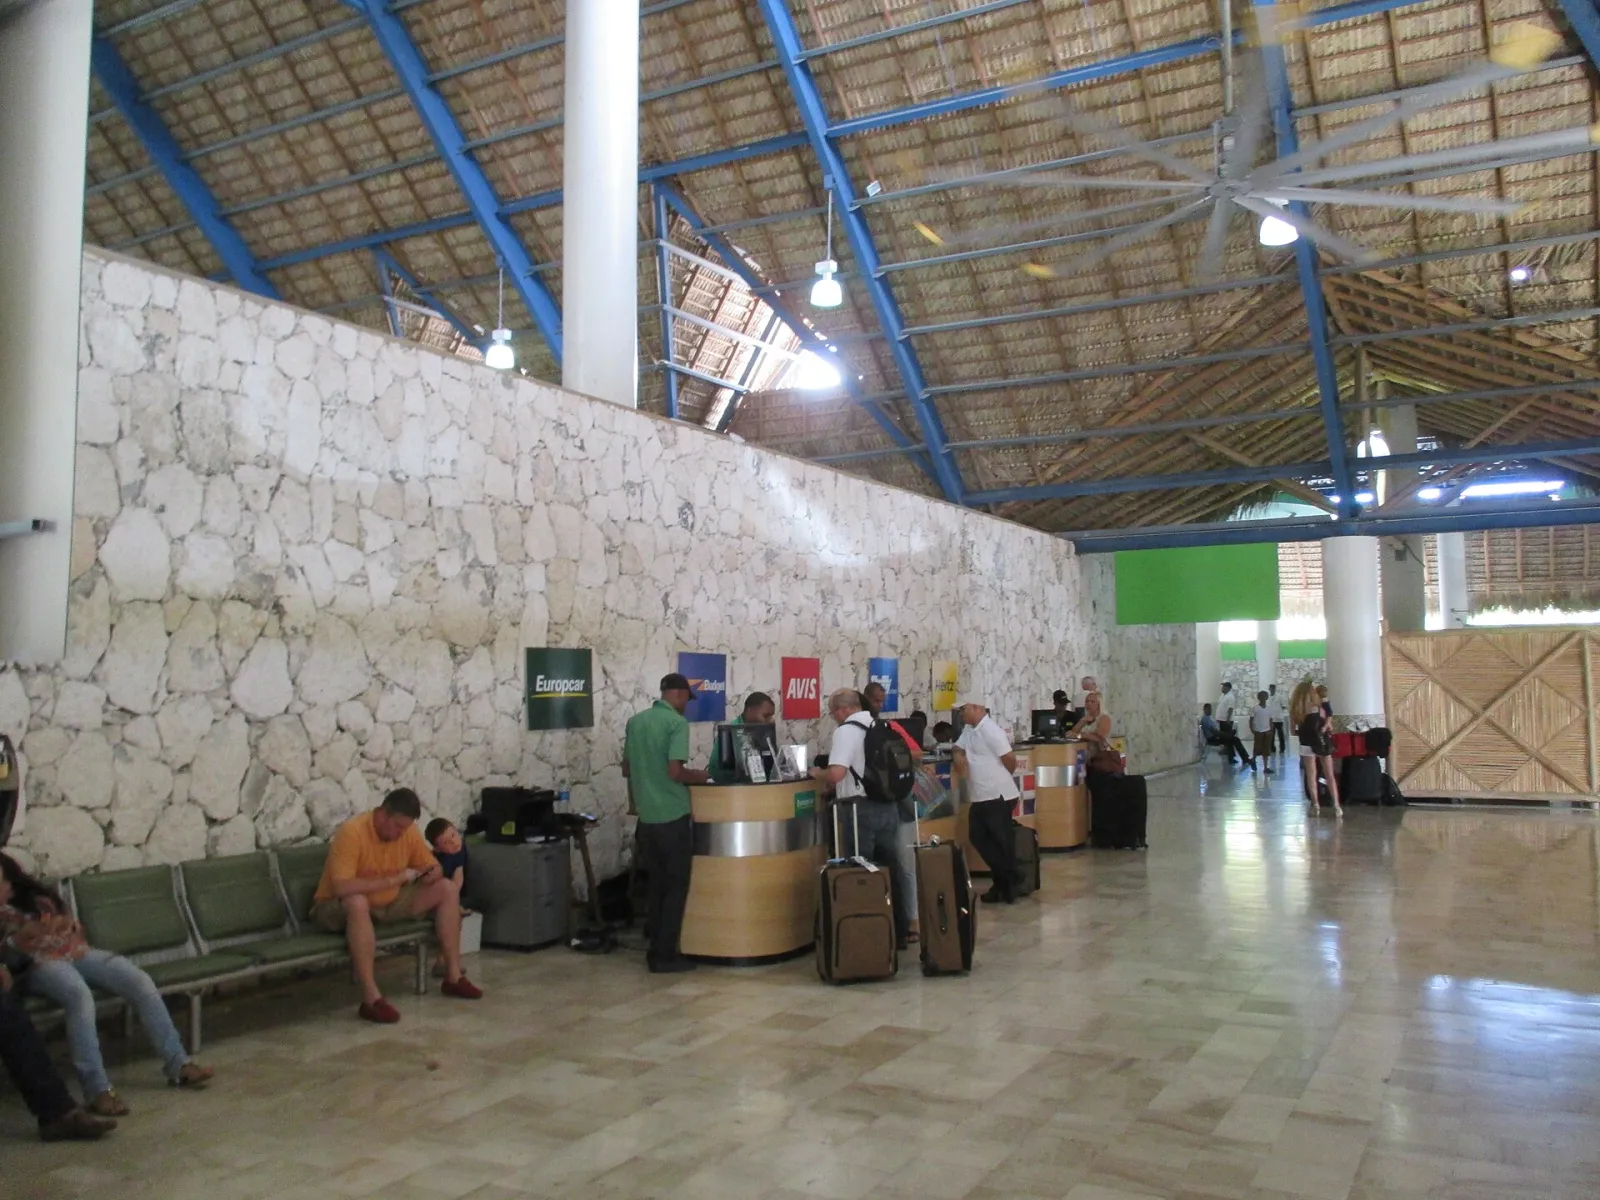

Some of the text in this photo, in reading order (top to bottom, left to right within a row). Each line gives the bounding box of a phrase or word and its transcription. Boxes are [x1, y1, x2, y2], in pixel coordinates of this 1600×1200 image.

[535, 674, 586, 696] Europcar
[704, 679, 725, 693] Budget
[786, 677, 817, 700] AVIS
[935, 679, 954, 691] Hertz
